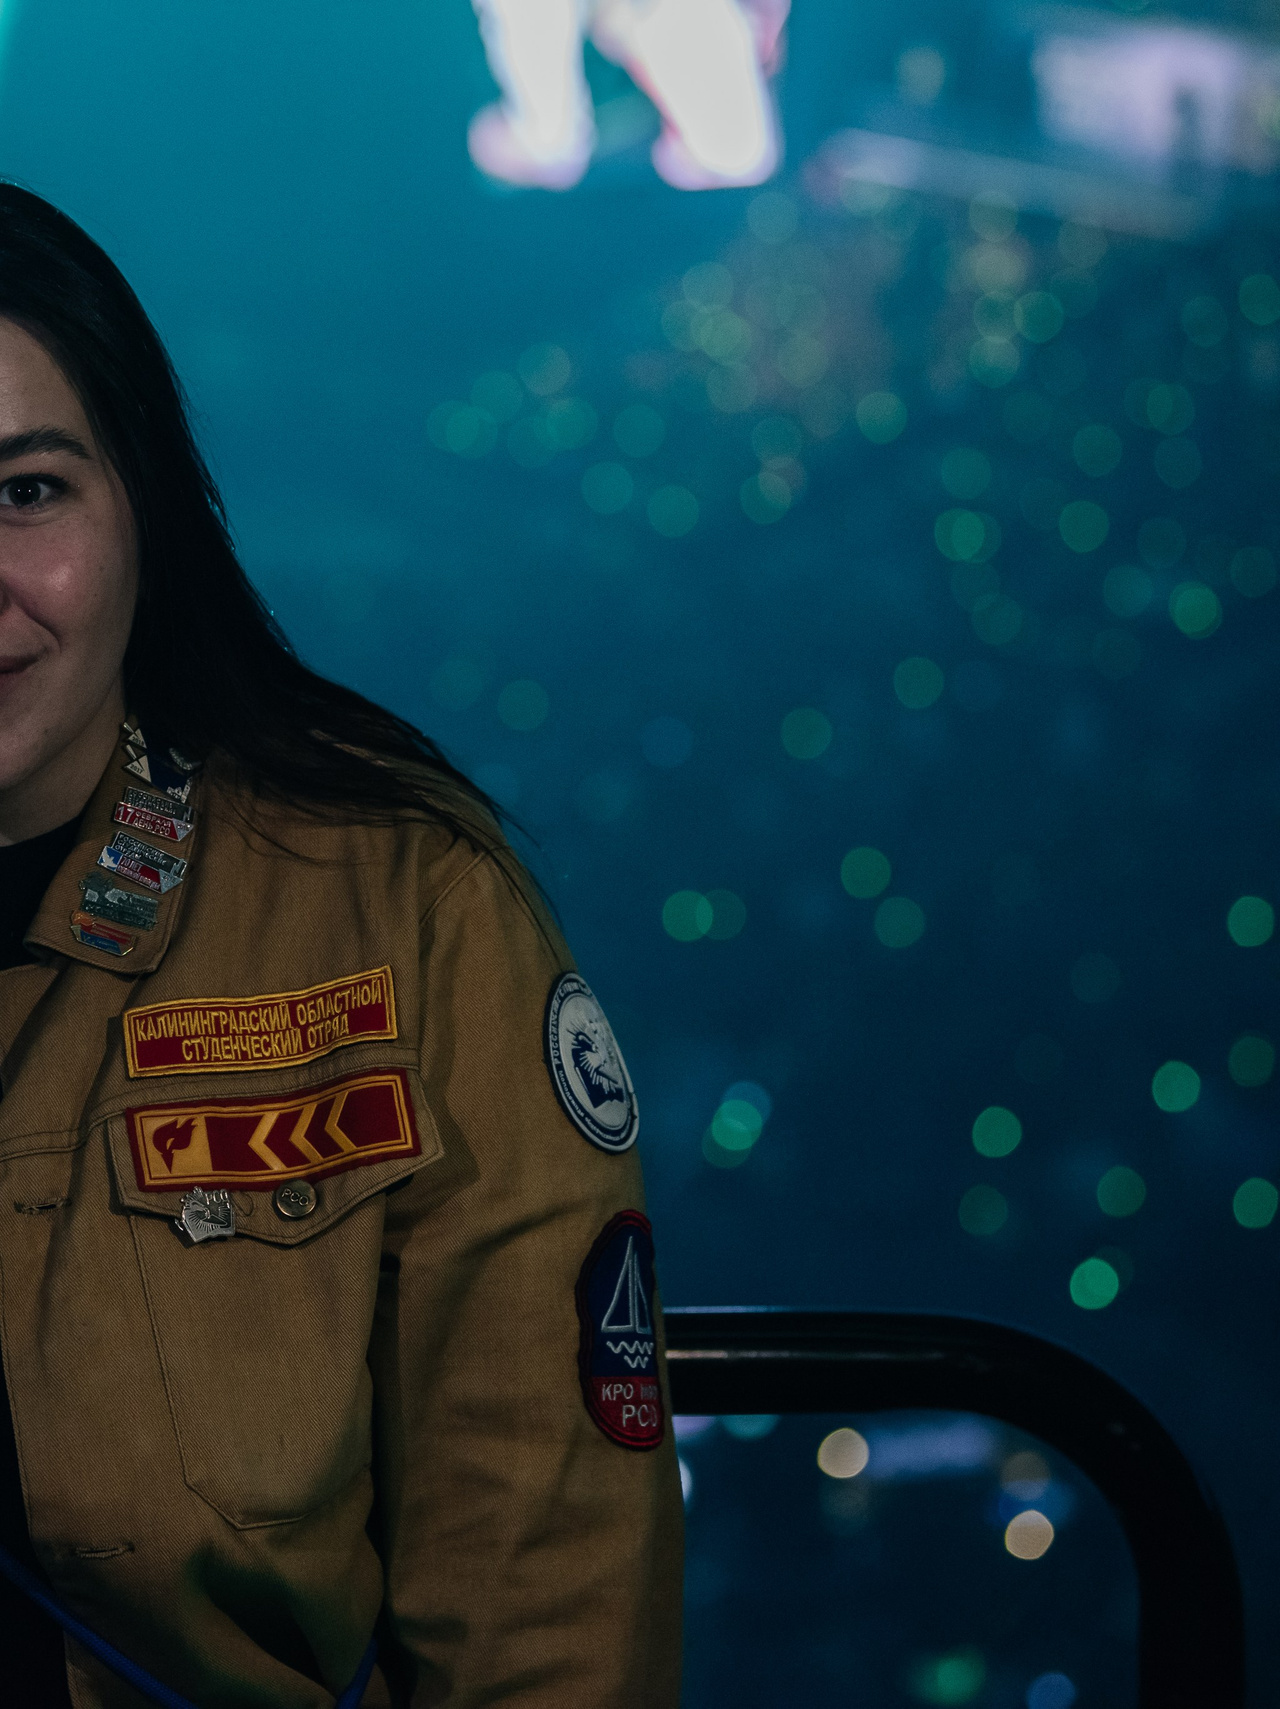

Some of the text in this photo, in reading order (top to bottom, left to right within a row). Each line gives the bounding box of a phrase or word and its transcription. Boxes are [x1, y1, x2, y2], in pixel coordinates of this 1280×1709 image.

[130, 764, 144, 774] 2017
[118, 806, 135, 823] 17
[135, 811, 172, 828] ФЕВРАЛЯ
[132, 817, 153, 830] ДЕНЬ
[154, 824, 171, 836] РСО
[136, 979, 383, 1043] КАЛИНИНГРАДСКИЙ ОБЛАСТНОЙ
[181, 1013, 350, 1062] СТУДЕНЧЕСКИЙ ОТРЯД
[205, 1188, 231, 1206] РСО
[281, 1188, 310, 1207] РСО
[602, 1383, 634, 1401] КРО
